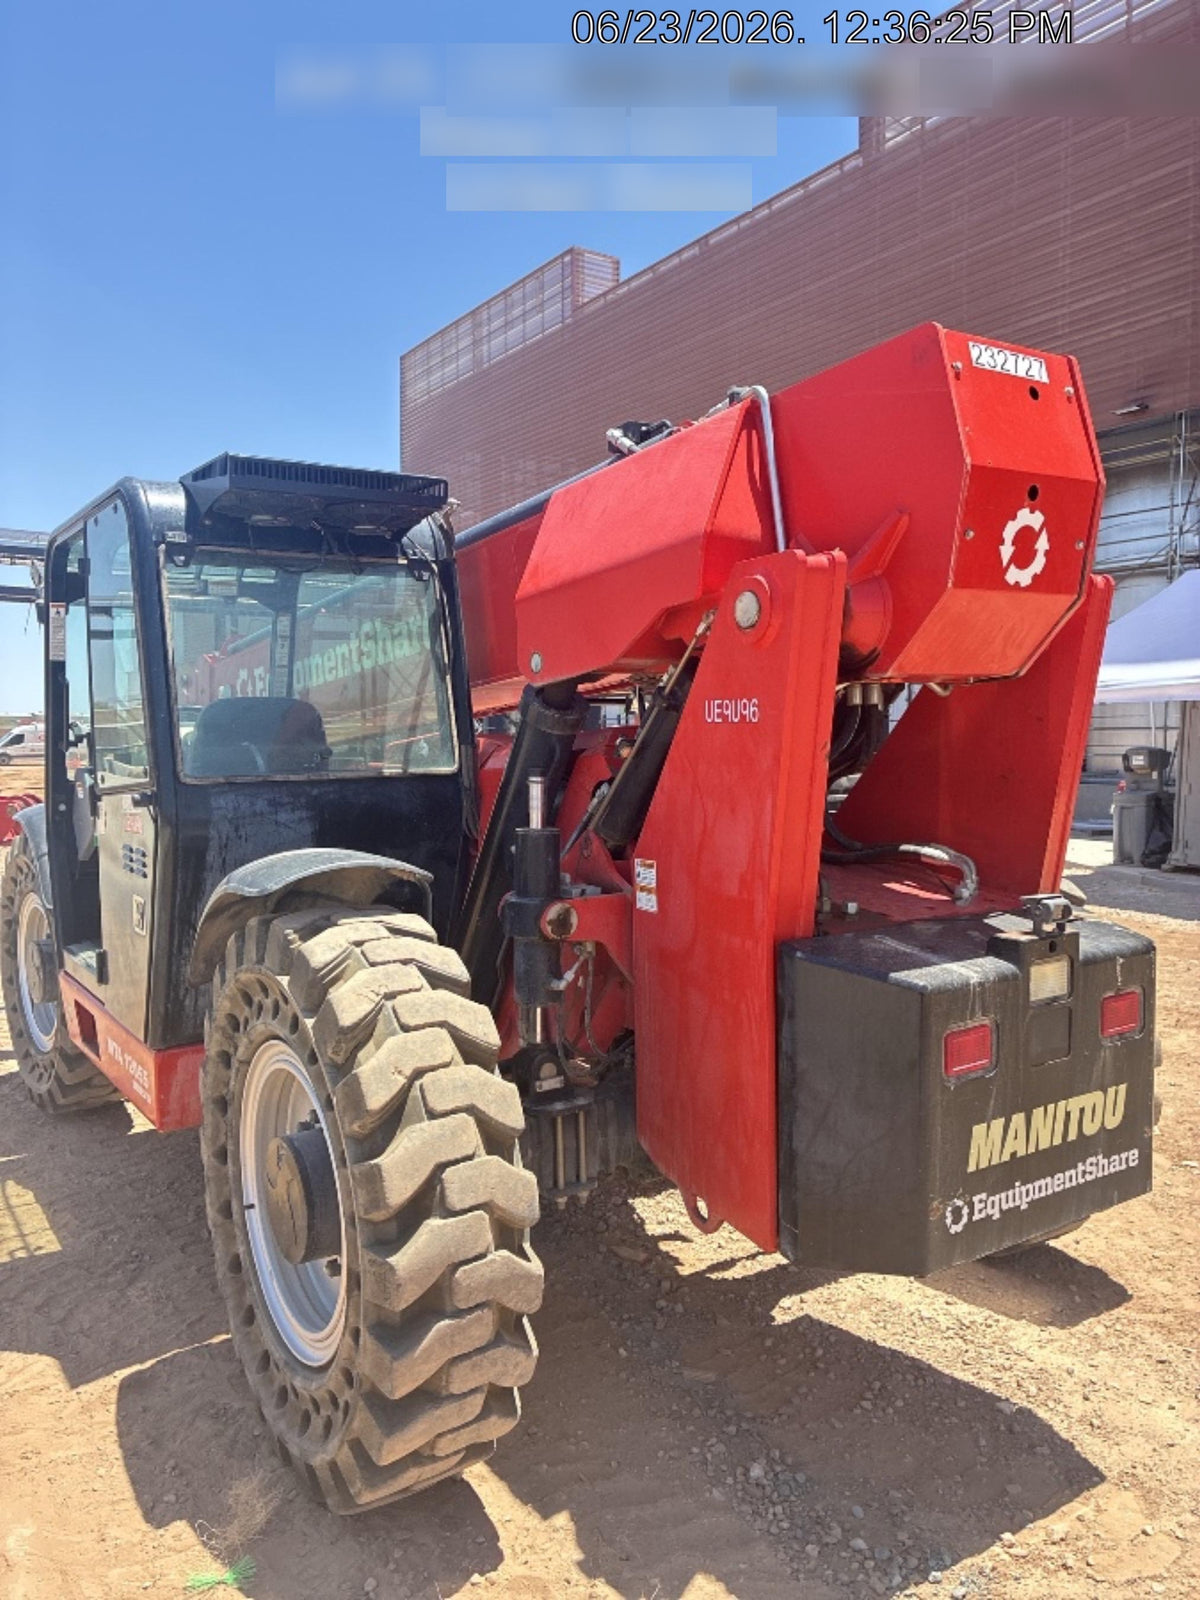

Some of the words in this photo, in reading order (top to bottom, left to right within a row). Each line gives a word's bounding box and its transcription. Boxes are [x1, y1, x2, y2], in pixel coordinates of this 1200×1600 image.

[970, 343, 1044, 380] 232727
[705, 698, 759, 722] UE9U96
[967, 1083, 1127, 1173] MANITOU
[972, 1148, 1139, 1222] EquipmentShare
